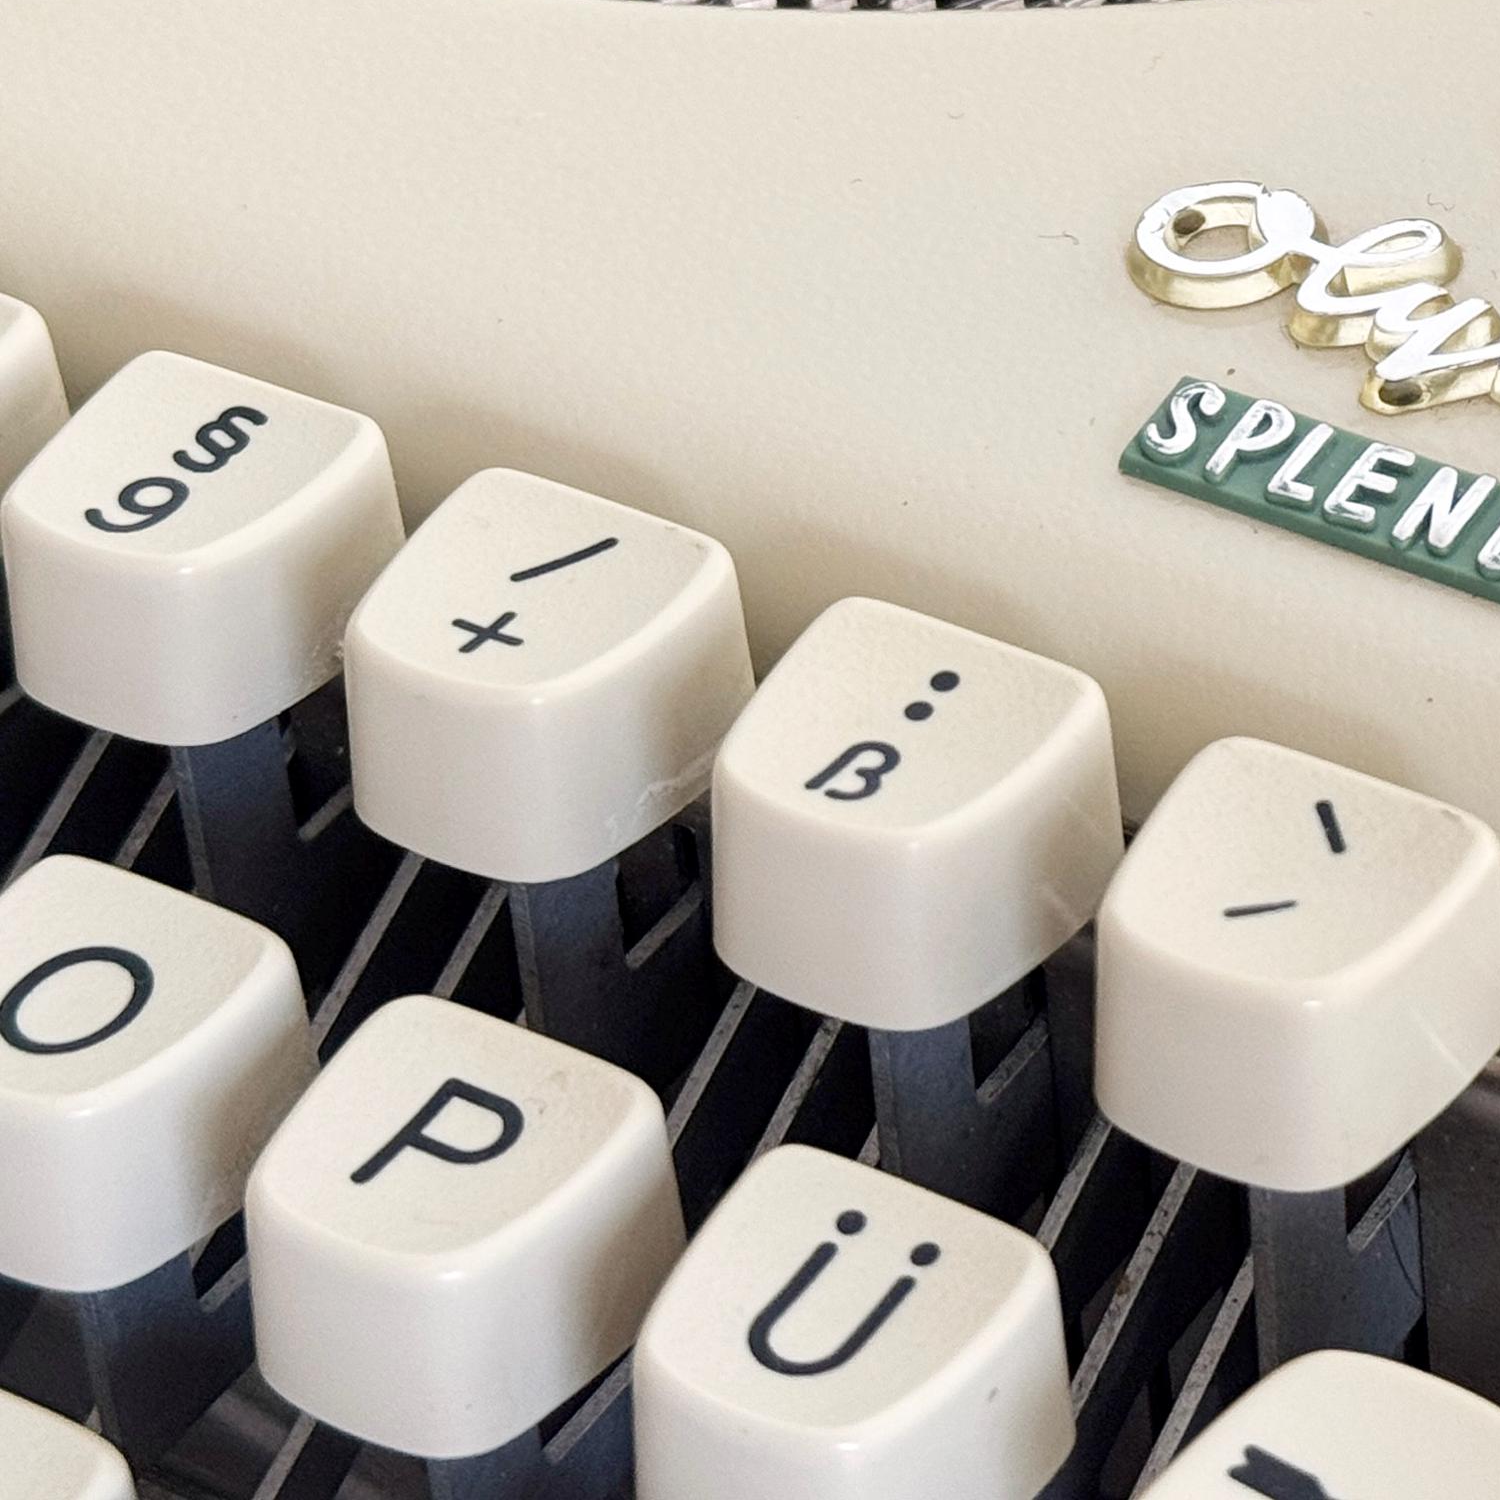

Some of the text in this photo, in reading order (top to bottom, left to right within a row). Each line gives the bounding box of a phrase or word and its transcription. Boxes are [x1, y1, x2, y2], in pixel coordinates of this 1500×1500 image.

[84, 476, 190, 533] 9
[0, 946, 155, 1055] O
[349, 1077, 525, 1185] P
[747, 1209, 942, 1377] Ü
